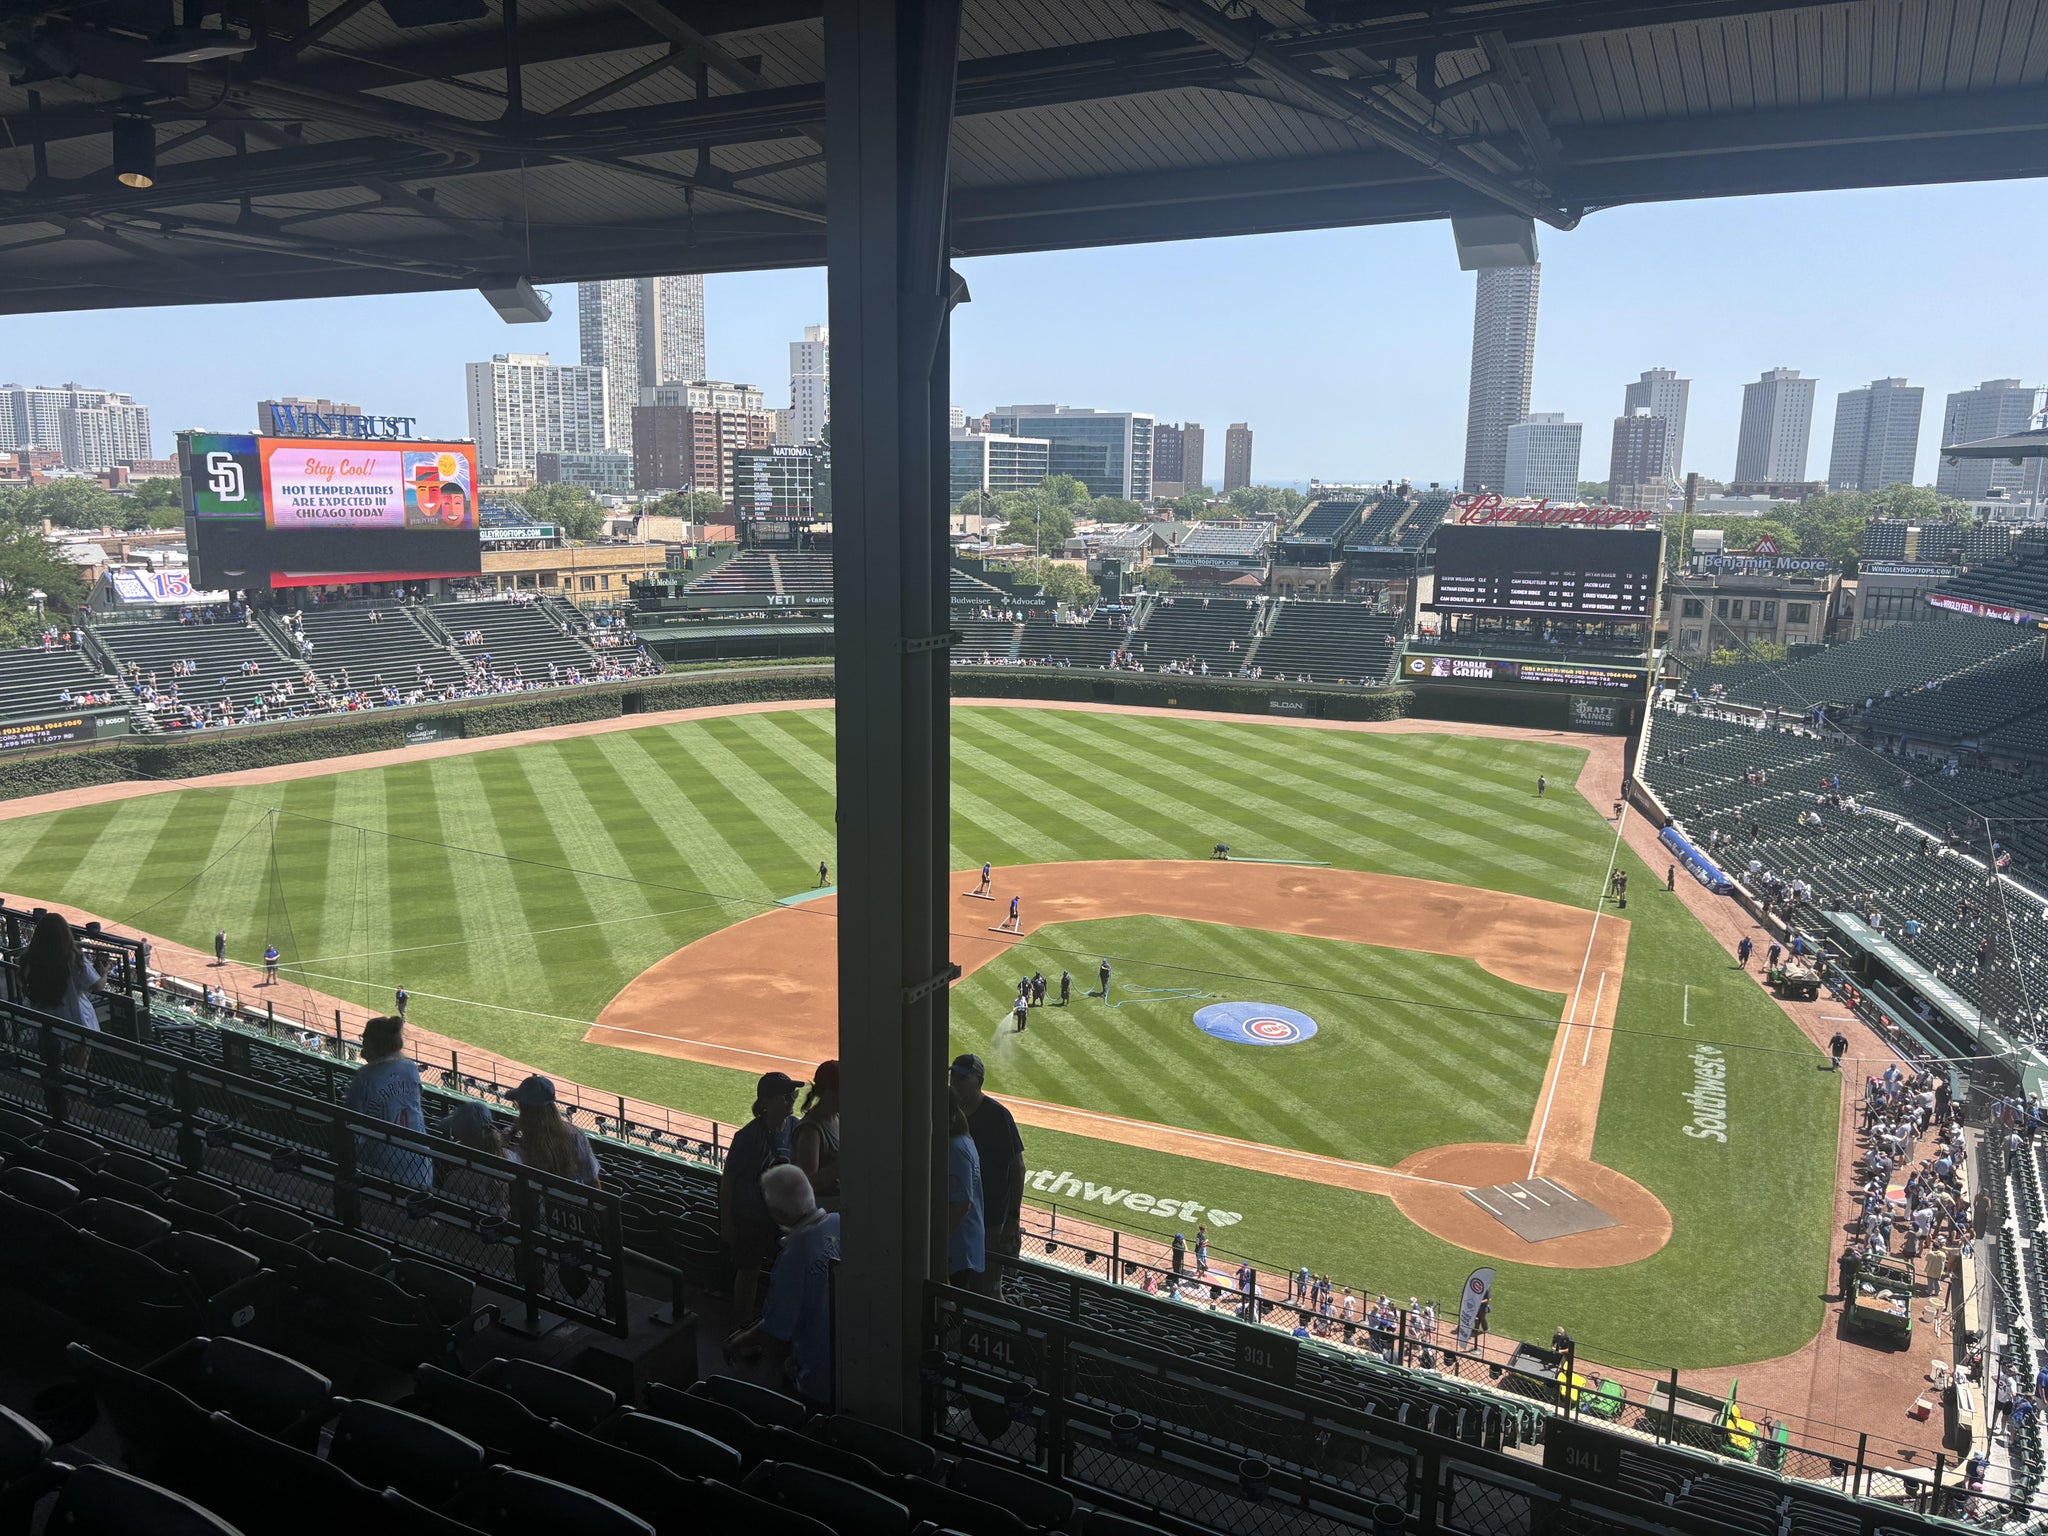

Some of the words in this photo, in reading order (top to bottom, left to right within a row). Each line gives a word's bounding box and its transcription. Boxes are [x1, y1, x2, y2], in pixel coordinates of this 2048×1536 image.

[270, 404, 416, 438] WINTRUST
[773, 447, 813, 456] NATIONAL
[304, 458, 336, 482] Stay
[340, 458, 376, 476] Cool!
[206, 452, 247, 501] SD
[282, 486, 306, 495] HOT
[310, 486, 394, 495] TEMPERATURES
[292, 498, 316, 506] ARE
[319, 498, 373, 506] EXPECTED
[375, 498, 387, 506] IN
[296, 509, 347, 518] CHICAGO
[350, 508, 385, 517] TODAY
[1453, 493, 1653, 525] Budweiser
[1704, 554, 1772, 571] Benjamin
[1776, 556, 1826, 571] Moore
[1871, 565, 1952, 575] WRIGLEYROOFTOPS.COM
[150, 572, 191, 597] 15
[656, 578, 678, 586] Mobile
[766, 595, 795, 605] YETI
[951, 596, 991, 605] Budweiser
[1011, 597, 1046, 605] Advocate
[1453, 660, 1487, 668] CHARLIE
[1453, 667, 1493, 678] GRIMM
[1269, 701, 1303, 709] SLOAN
[1576, 705, 1614, 714] DRAFT
[105, 717, 126, 725] BOSCH
[1580, 713, 1612, 721] KINGS
[1575, 719, 1614, 727] SPORTSBOOK
[406, 729, 437, 738] Gallagher
[1681, 1053, 1727, 1143] Southwest
[550, 1205, 586, 1234] 413L
